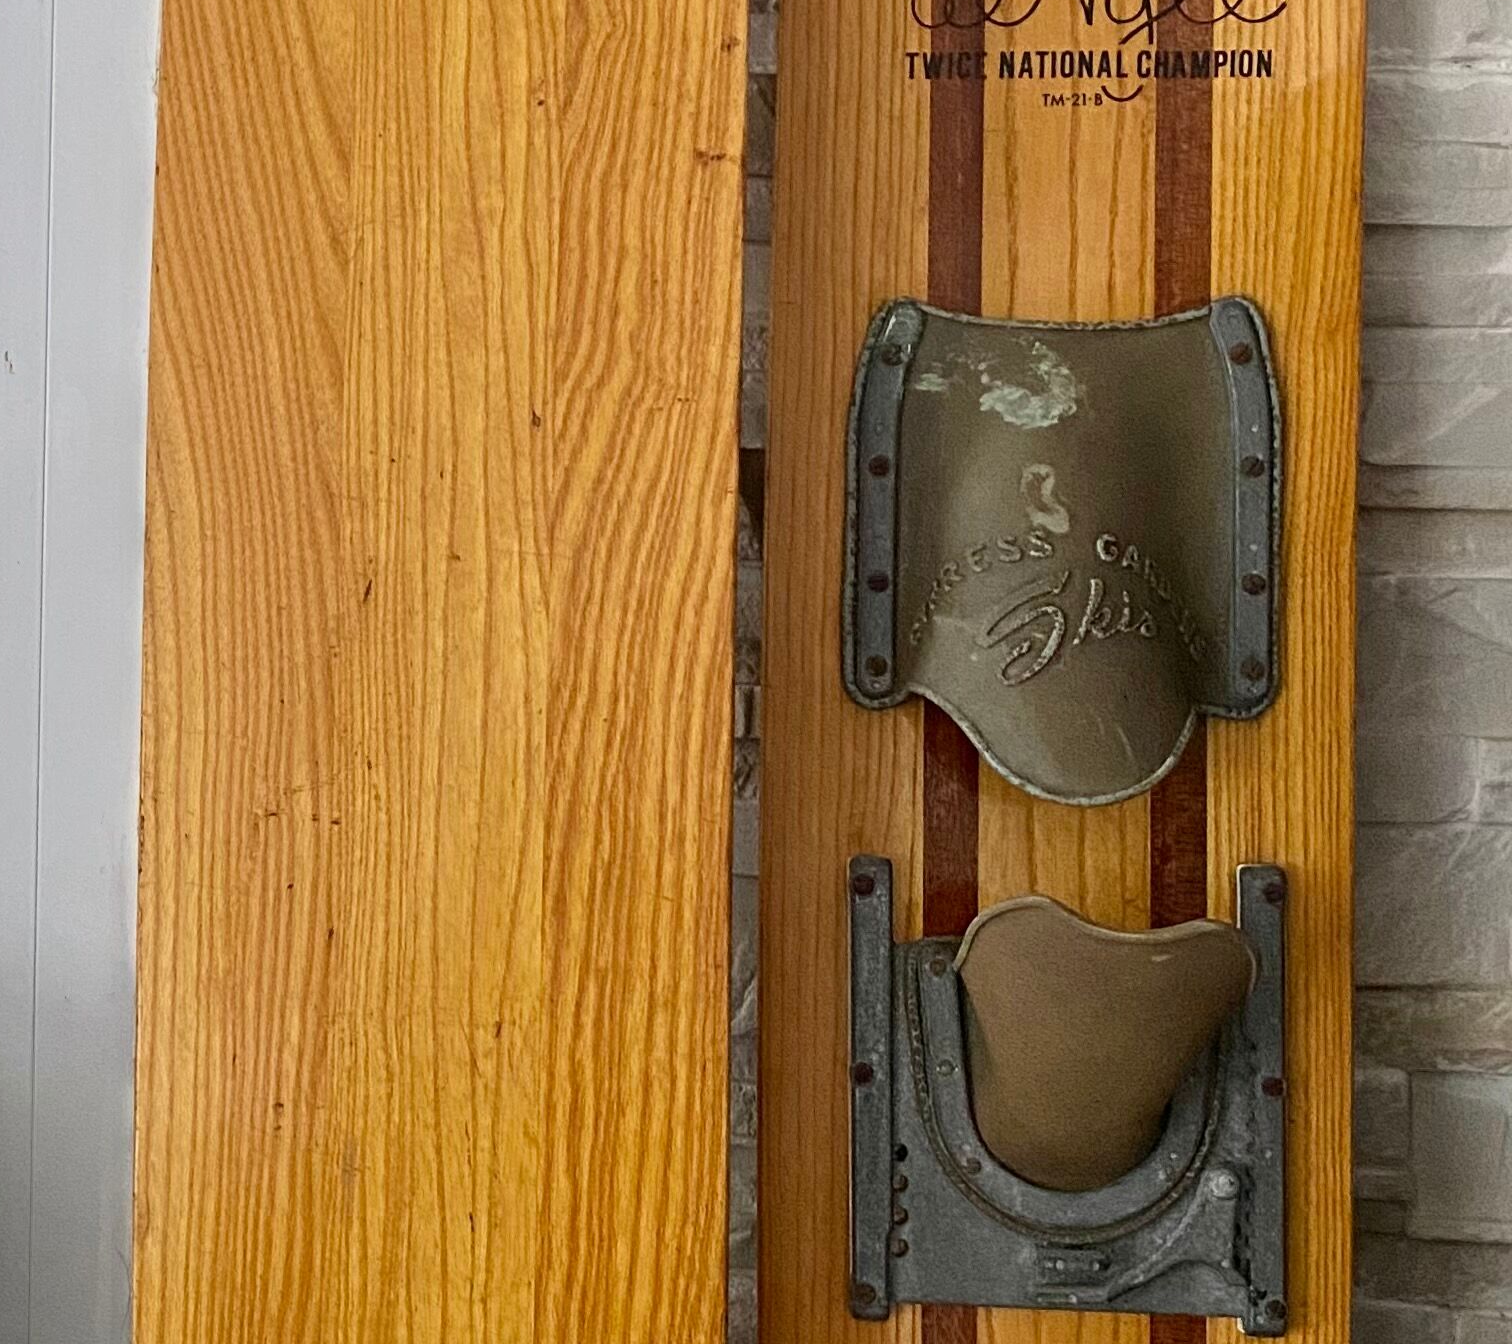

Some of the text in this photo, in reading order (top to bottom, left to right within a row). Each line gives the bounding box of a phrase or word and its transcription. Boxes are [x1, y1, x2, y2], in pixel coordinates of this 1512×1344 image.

[906, 49, 1273, 80] TWICE NATIONAL CHAMPION
